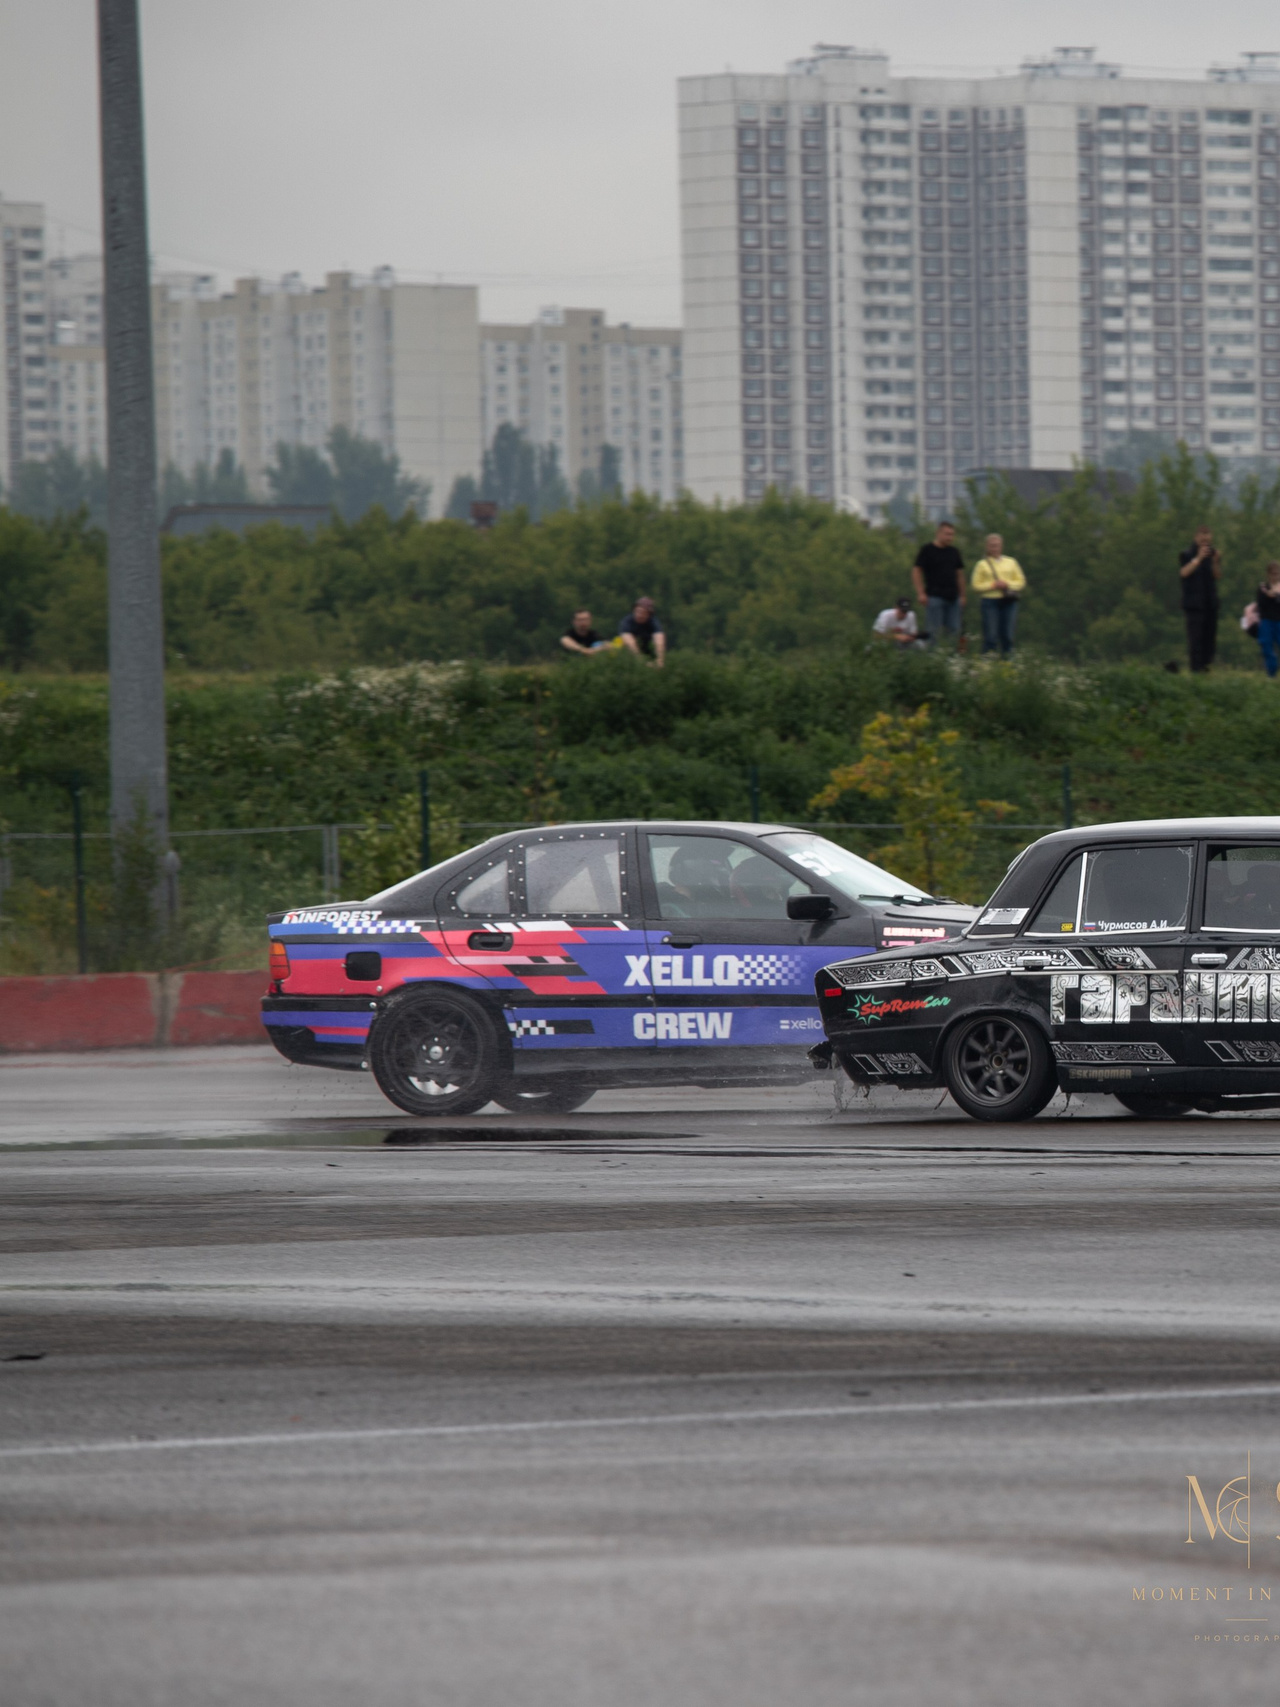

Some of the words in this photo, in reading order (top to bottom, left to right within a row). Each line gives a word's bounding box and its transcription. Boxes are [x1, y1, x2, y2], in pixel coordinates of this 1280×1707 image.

[1098, 920, 1147, 931] Чурмасов
[623, 955, 739, 987] XELLO
[633, 1012, 733, 1040] CREW
